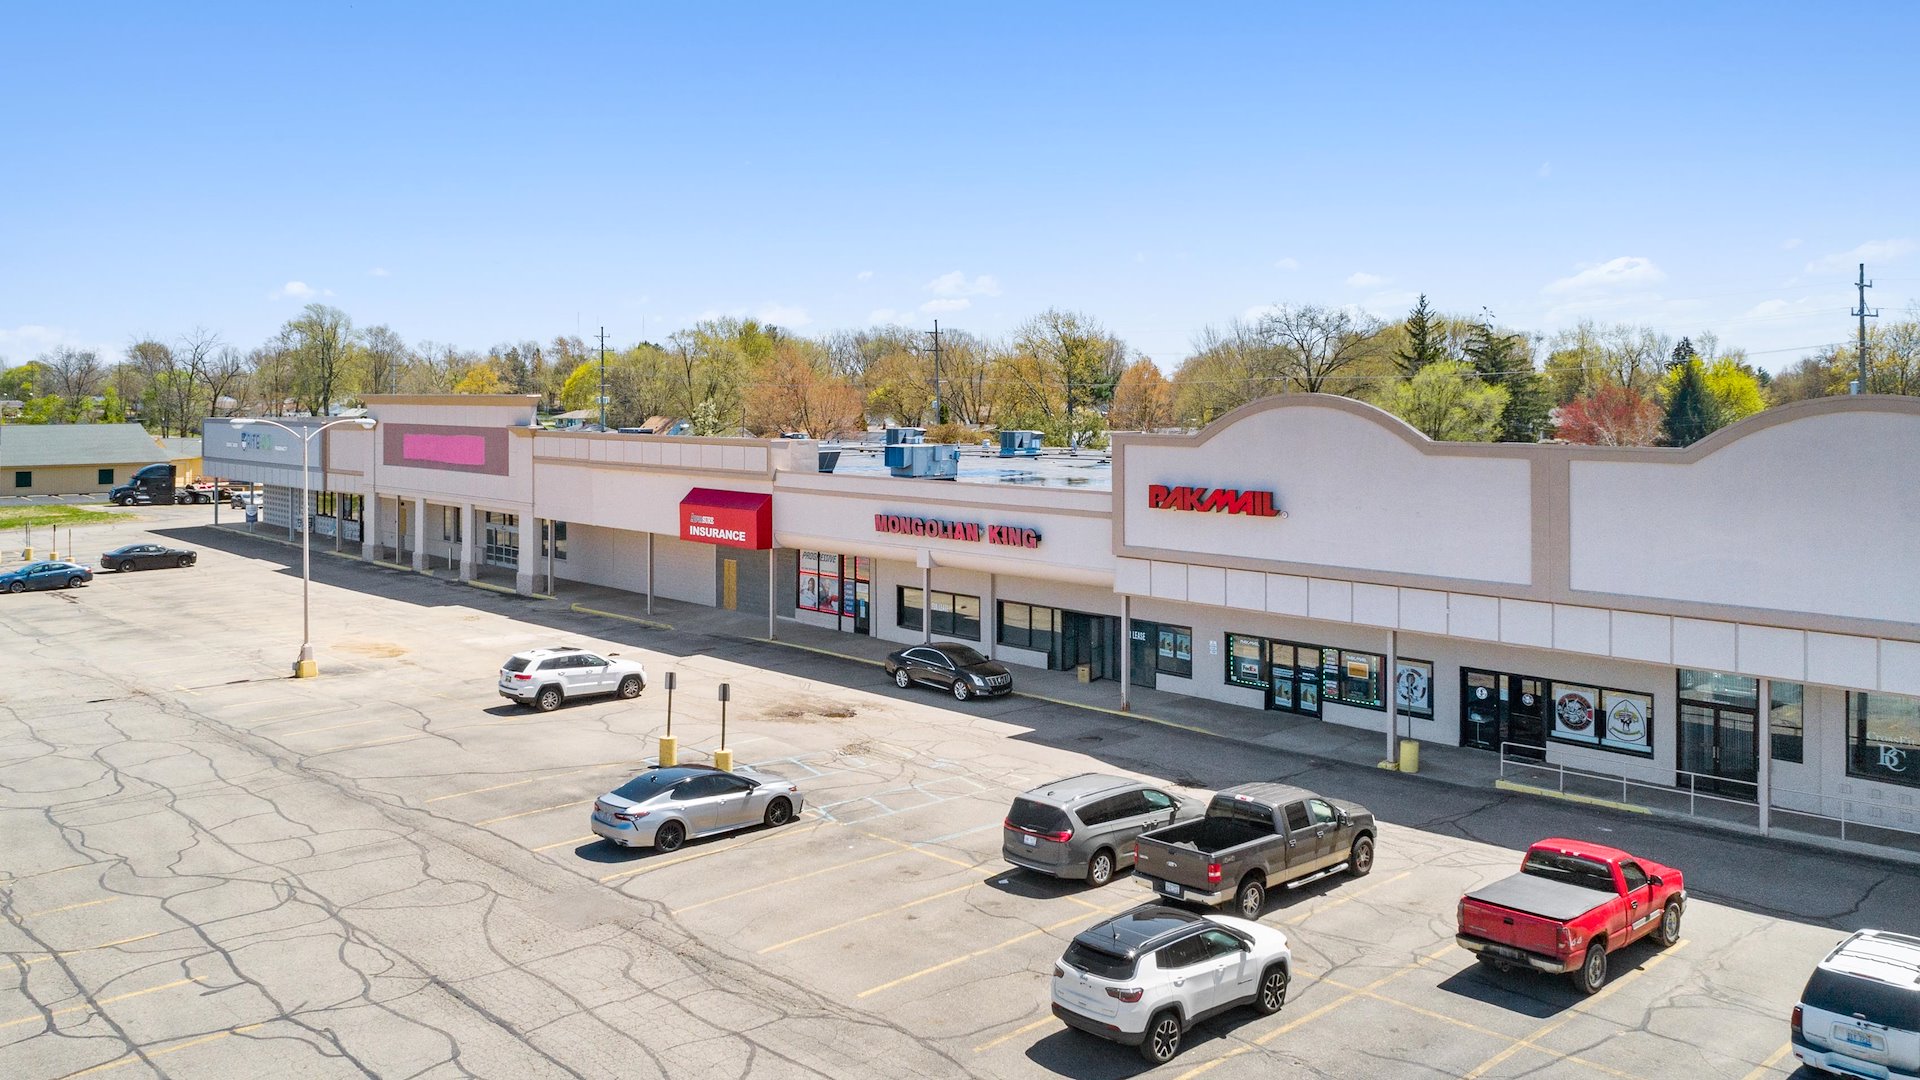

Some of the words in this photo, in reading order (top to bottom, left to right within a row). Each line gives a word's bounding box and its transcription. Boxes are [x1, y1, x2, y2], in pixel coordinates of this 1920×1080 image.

[689, 526, 746, 542] INSURANCE
[874, 514, 981, 543] MONGOLIAN
[988, 525, 1039, 549] KING
[802, 551, 837, 563] PROGESSIVE
[1132, 631, 1146, 641] LEASE
[1242, 664, 1257, 673] FedEx
